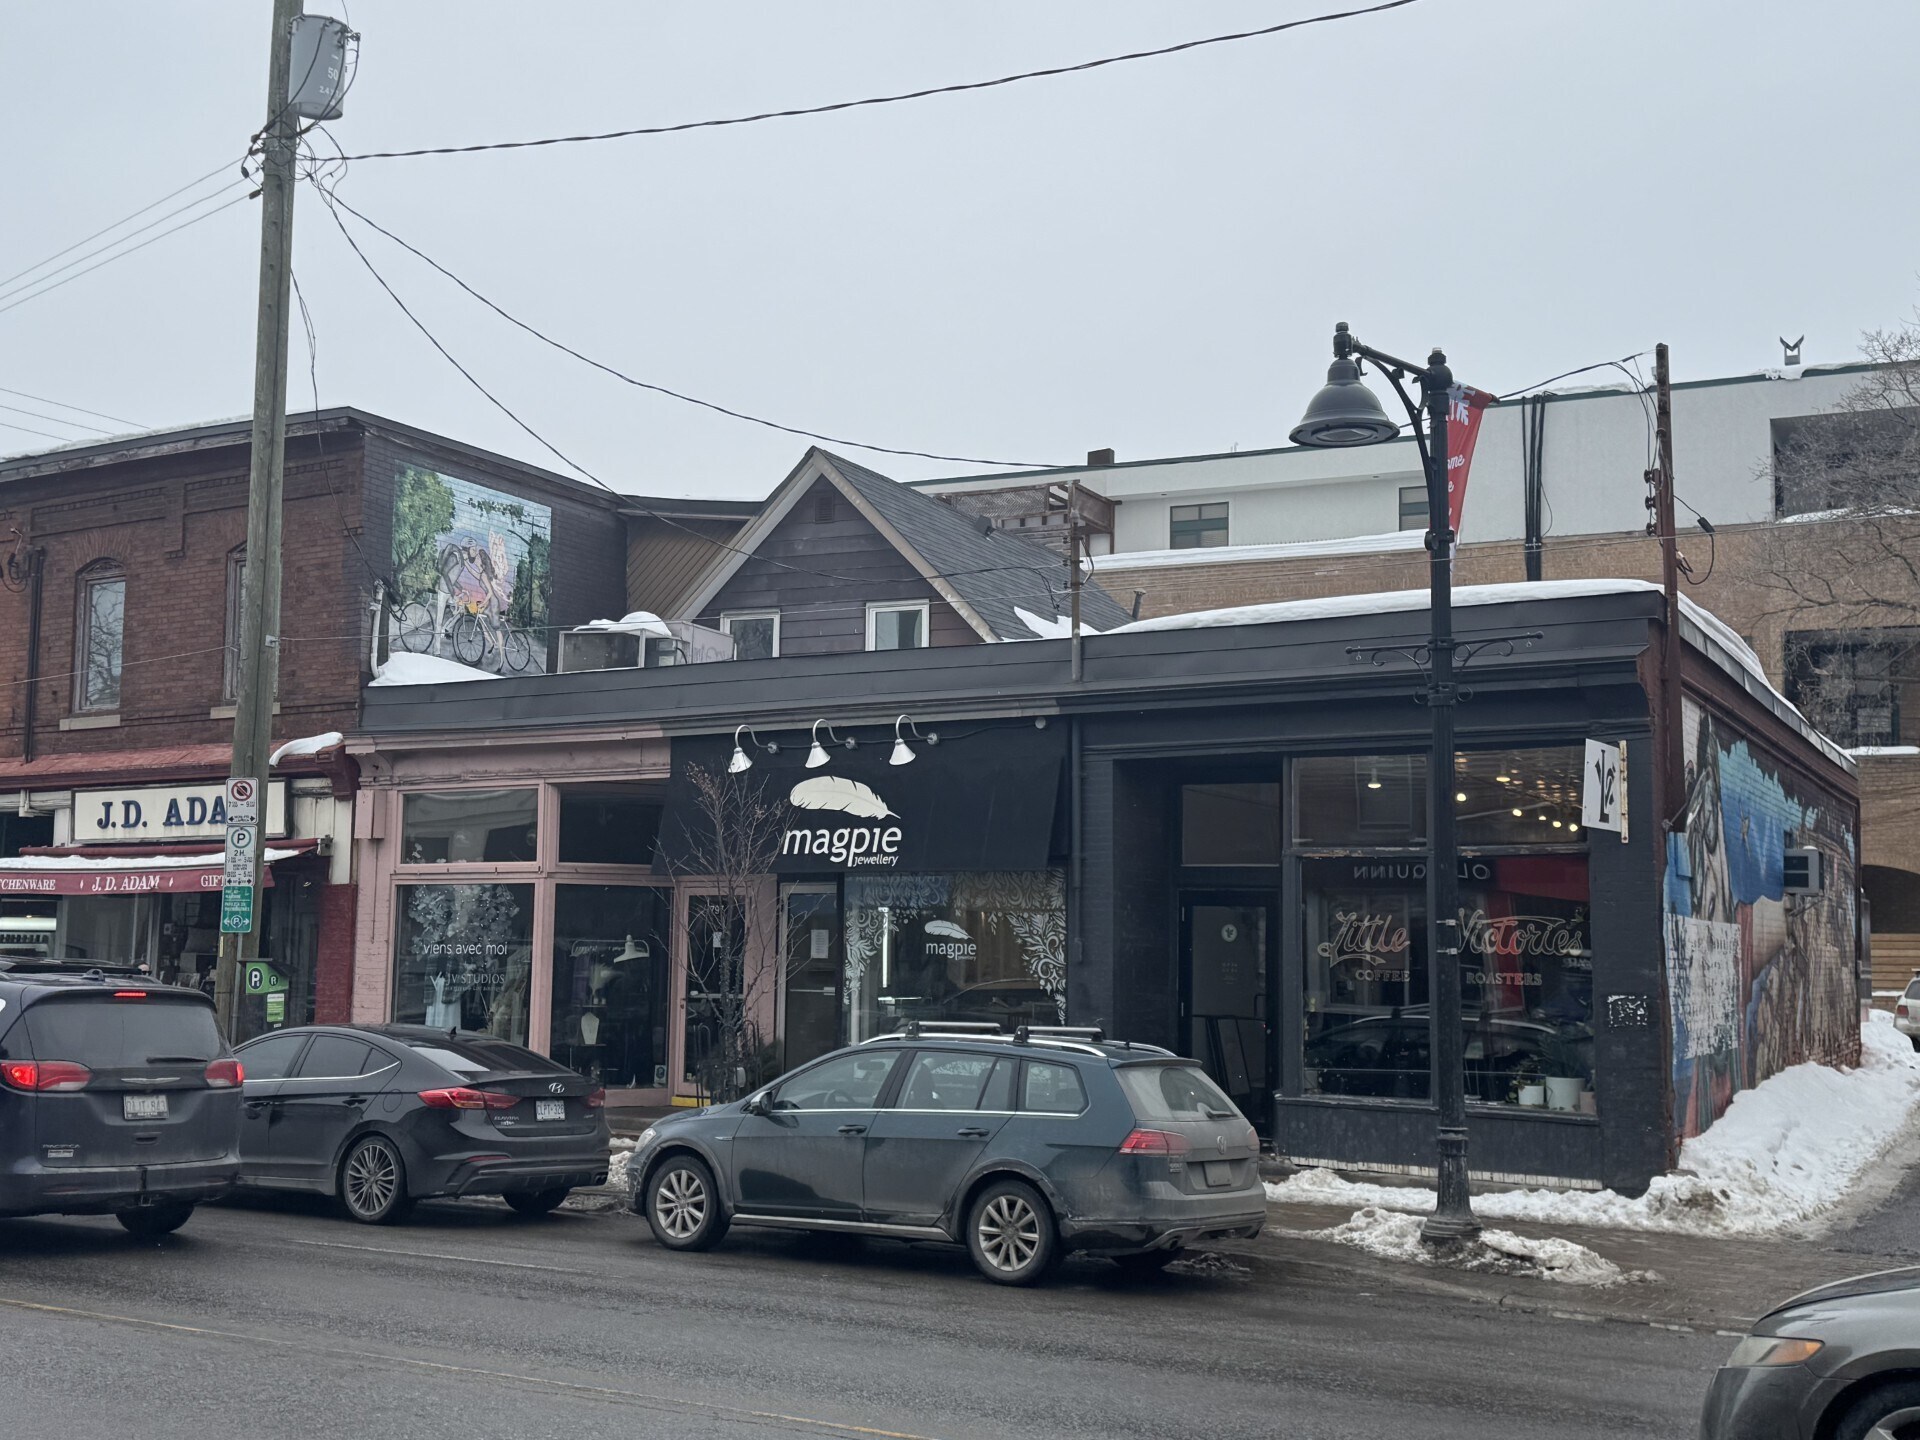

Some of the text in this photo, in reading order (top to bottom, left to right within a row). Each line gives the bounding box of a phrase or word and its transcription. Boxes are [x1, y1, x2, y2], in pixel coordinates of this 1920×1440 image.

[163, 796, 226, 826] ADA
[783, 826, 902, 867] magpie
[852, 854, 899, 867] jewellery
[0, 878, 56, 891] CHENWARE
[120, 875, 160, 891] ADAM
[1317, 907, 1582, 968] Little Victories
[423, 941, 508, 955] viens avec moi
[926, 942, 977, 961] magpie
[461, 973, 505, 984] STUDIOS
[1355, 969, 1543, 986] COFFEE ROASTERS
